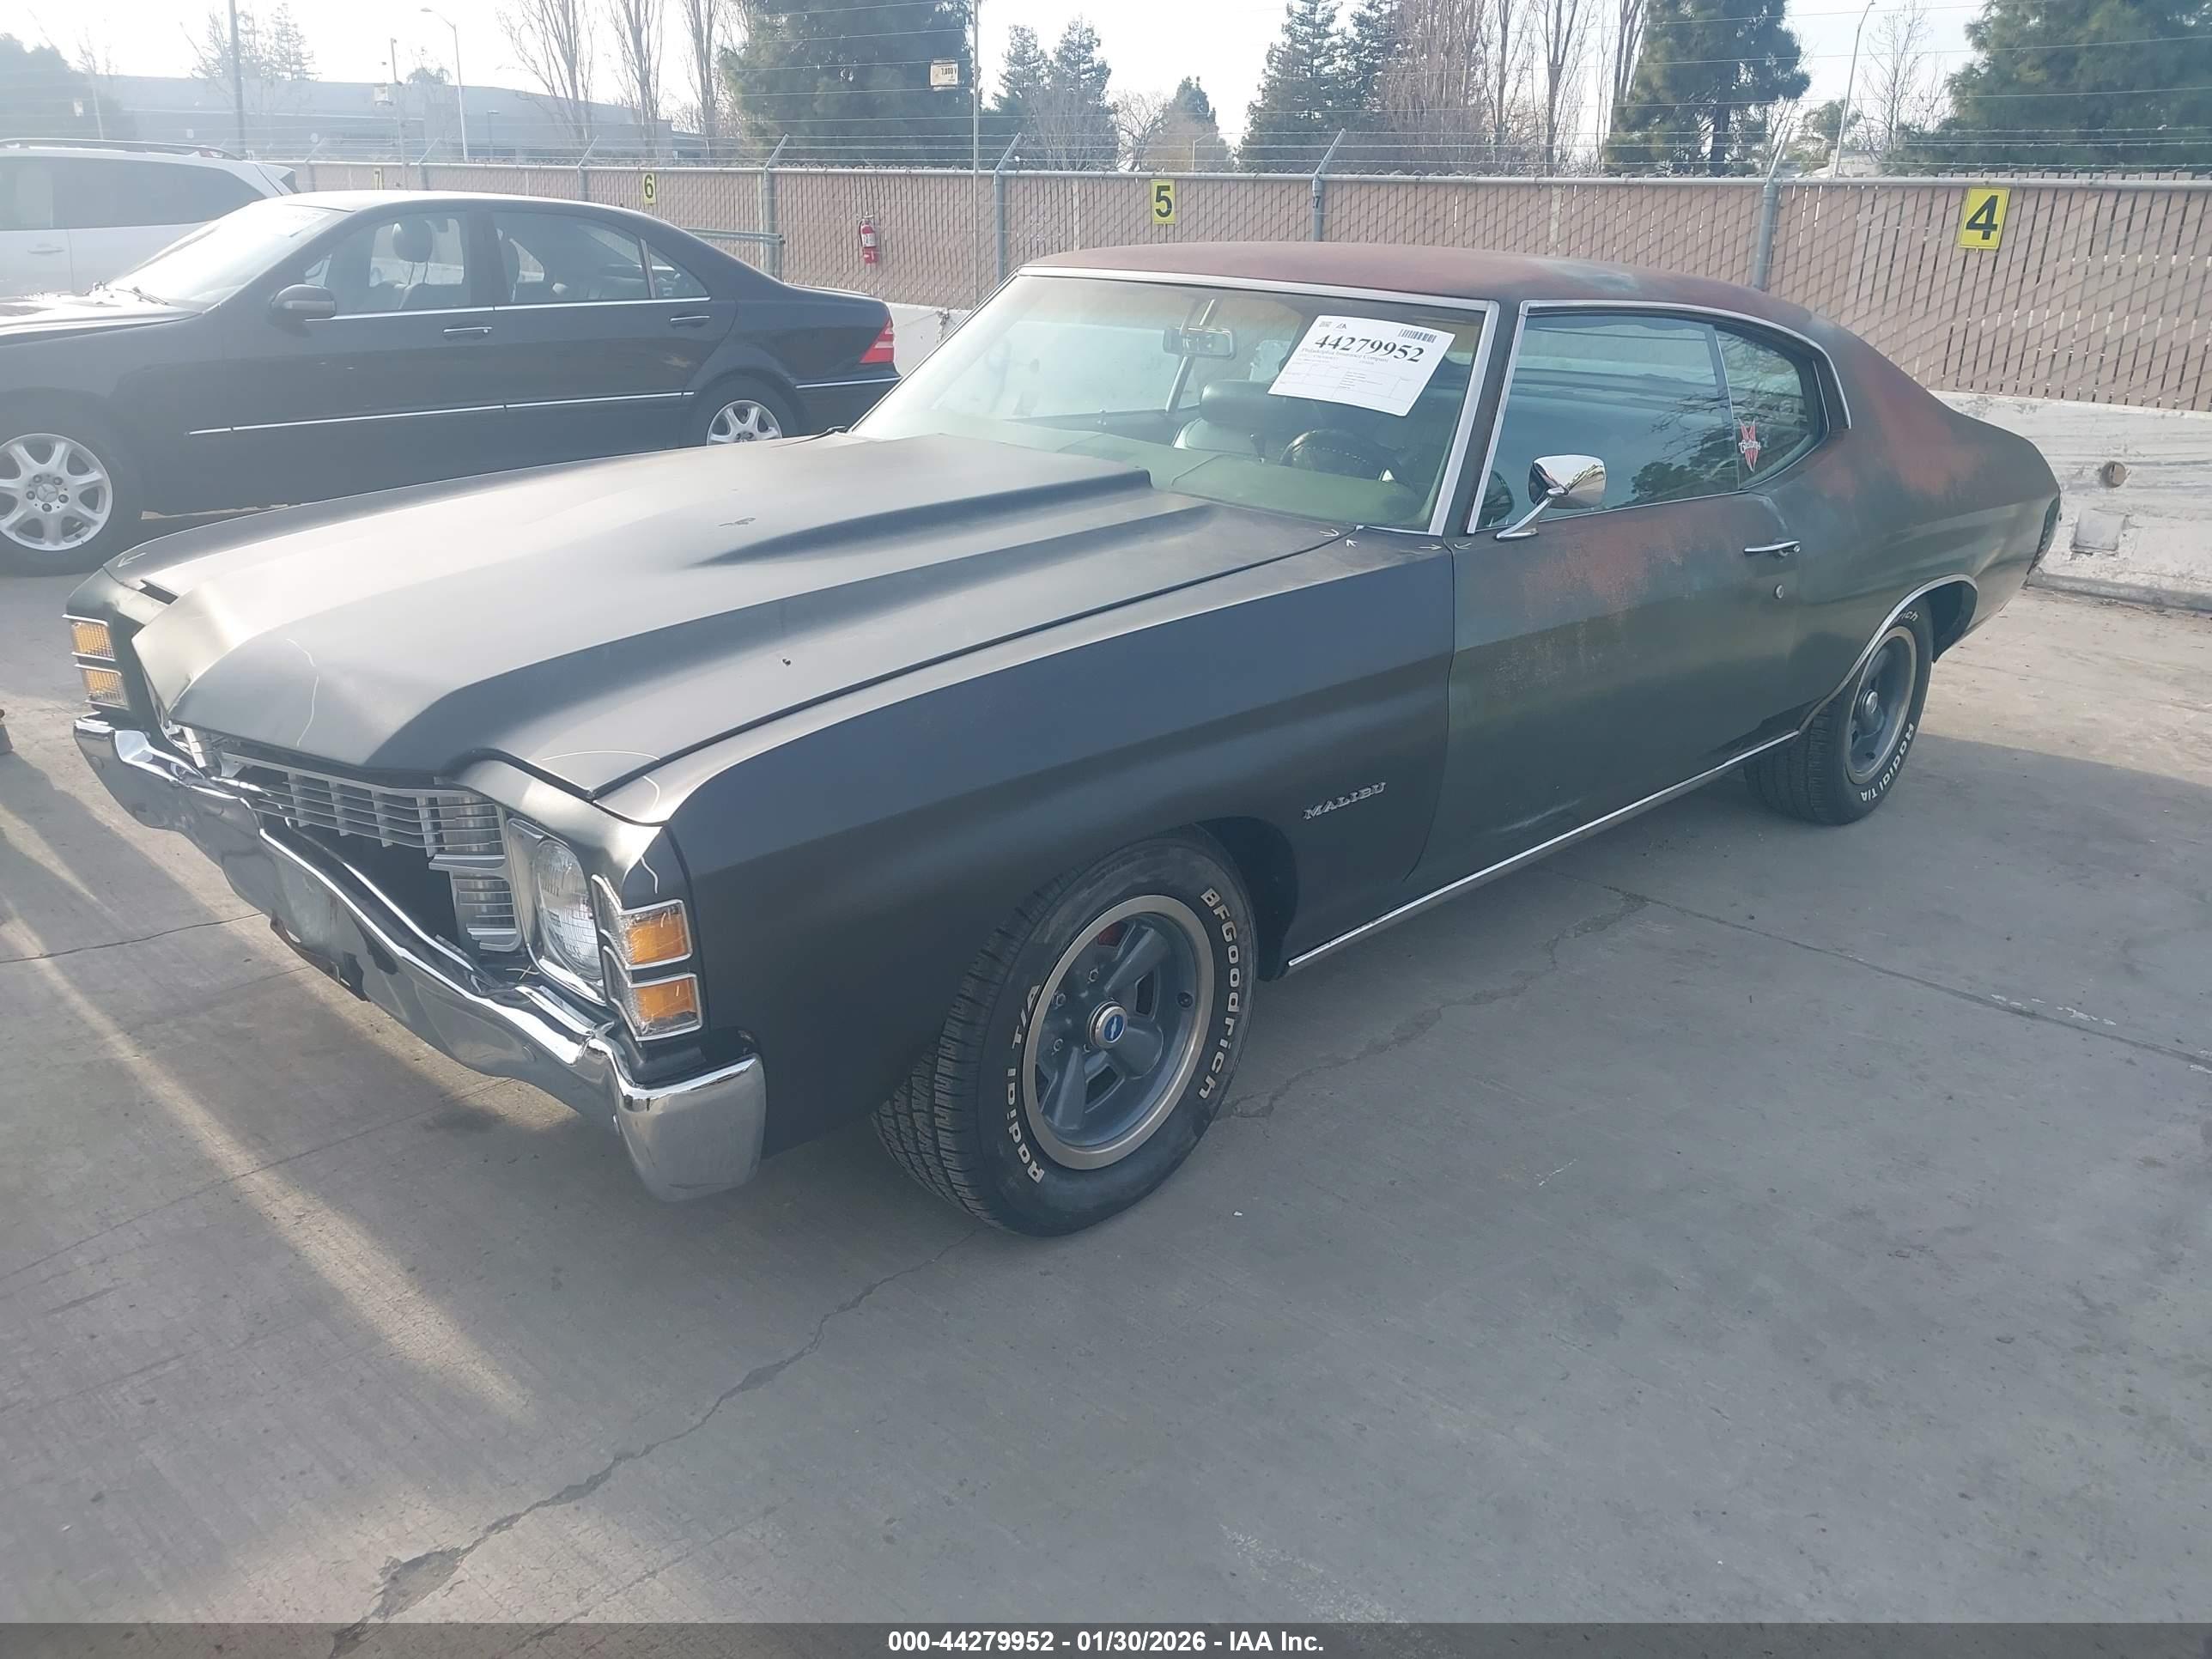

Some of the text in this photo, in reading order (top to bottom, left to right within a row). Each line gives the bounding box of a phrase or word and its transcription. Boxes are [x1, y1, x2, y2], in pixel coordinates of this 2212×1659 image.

[644, 174, 653, 198] 6
[1156, 185, 1172, 217] 5
[1966, 195, 1998, 240] 4
[1315, 334, 1425, 362] 44279952
[1304, 782, 1386, 819] MALIBU
[1861, 787, 1878, 801] T/A
[1200, 887, 1240, 1100] BFGoodrich
